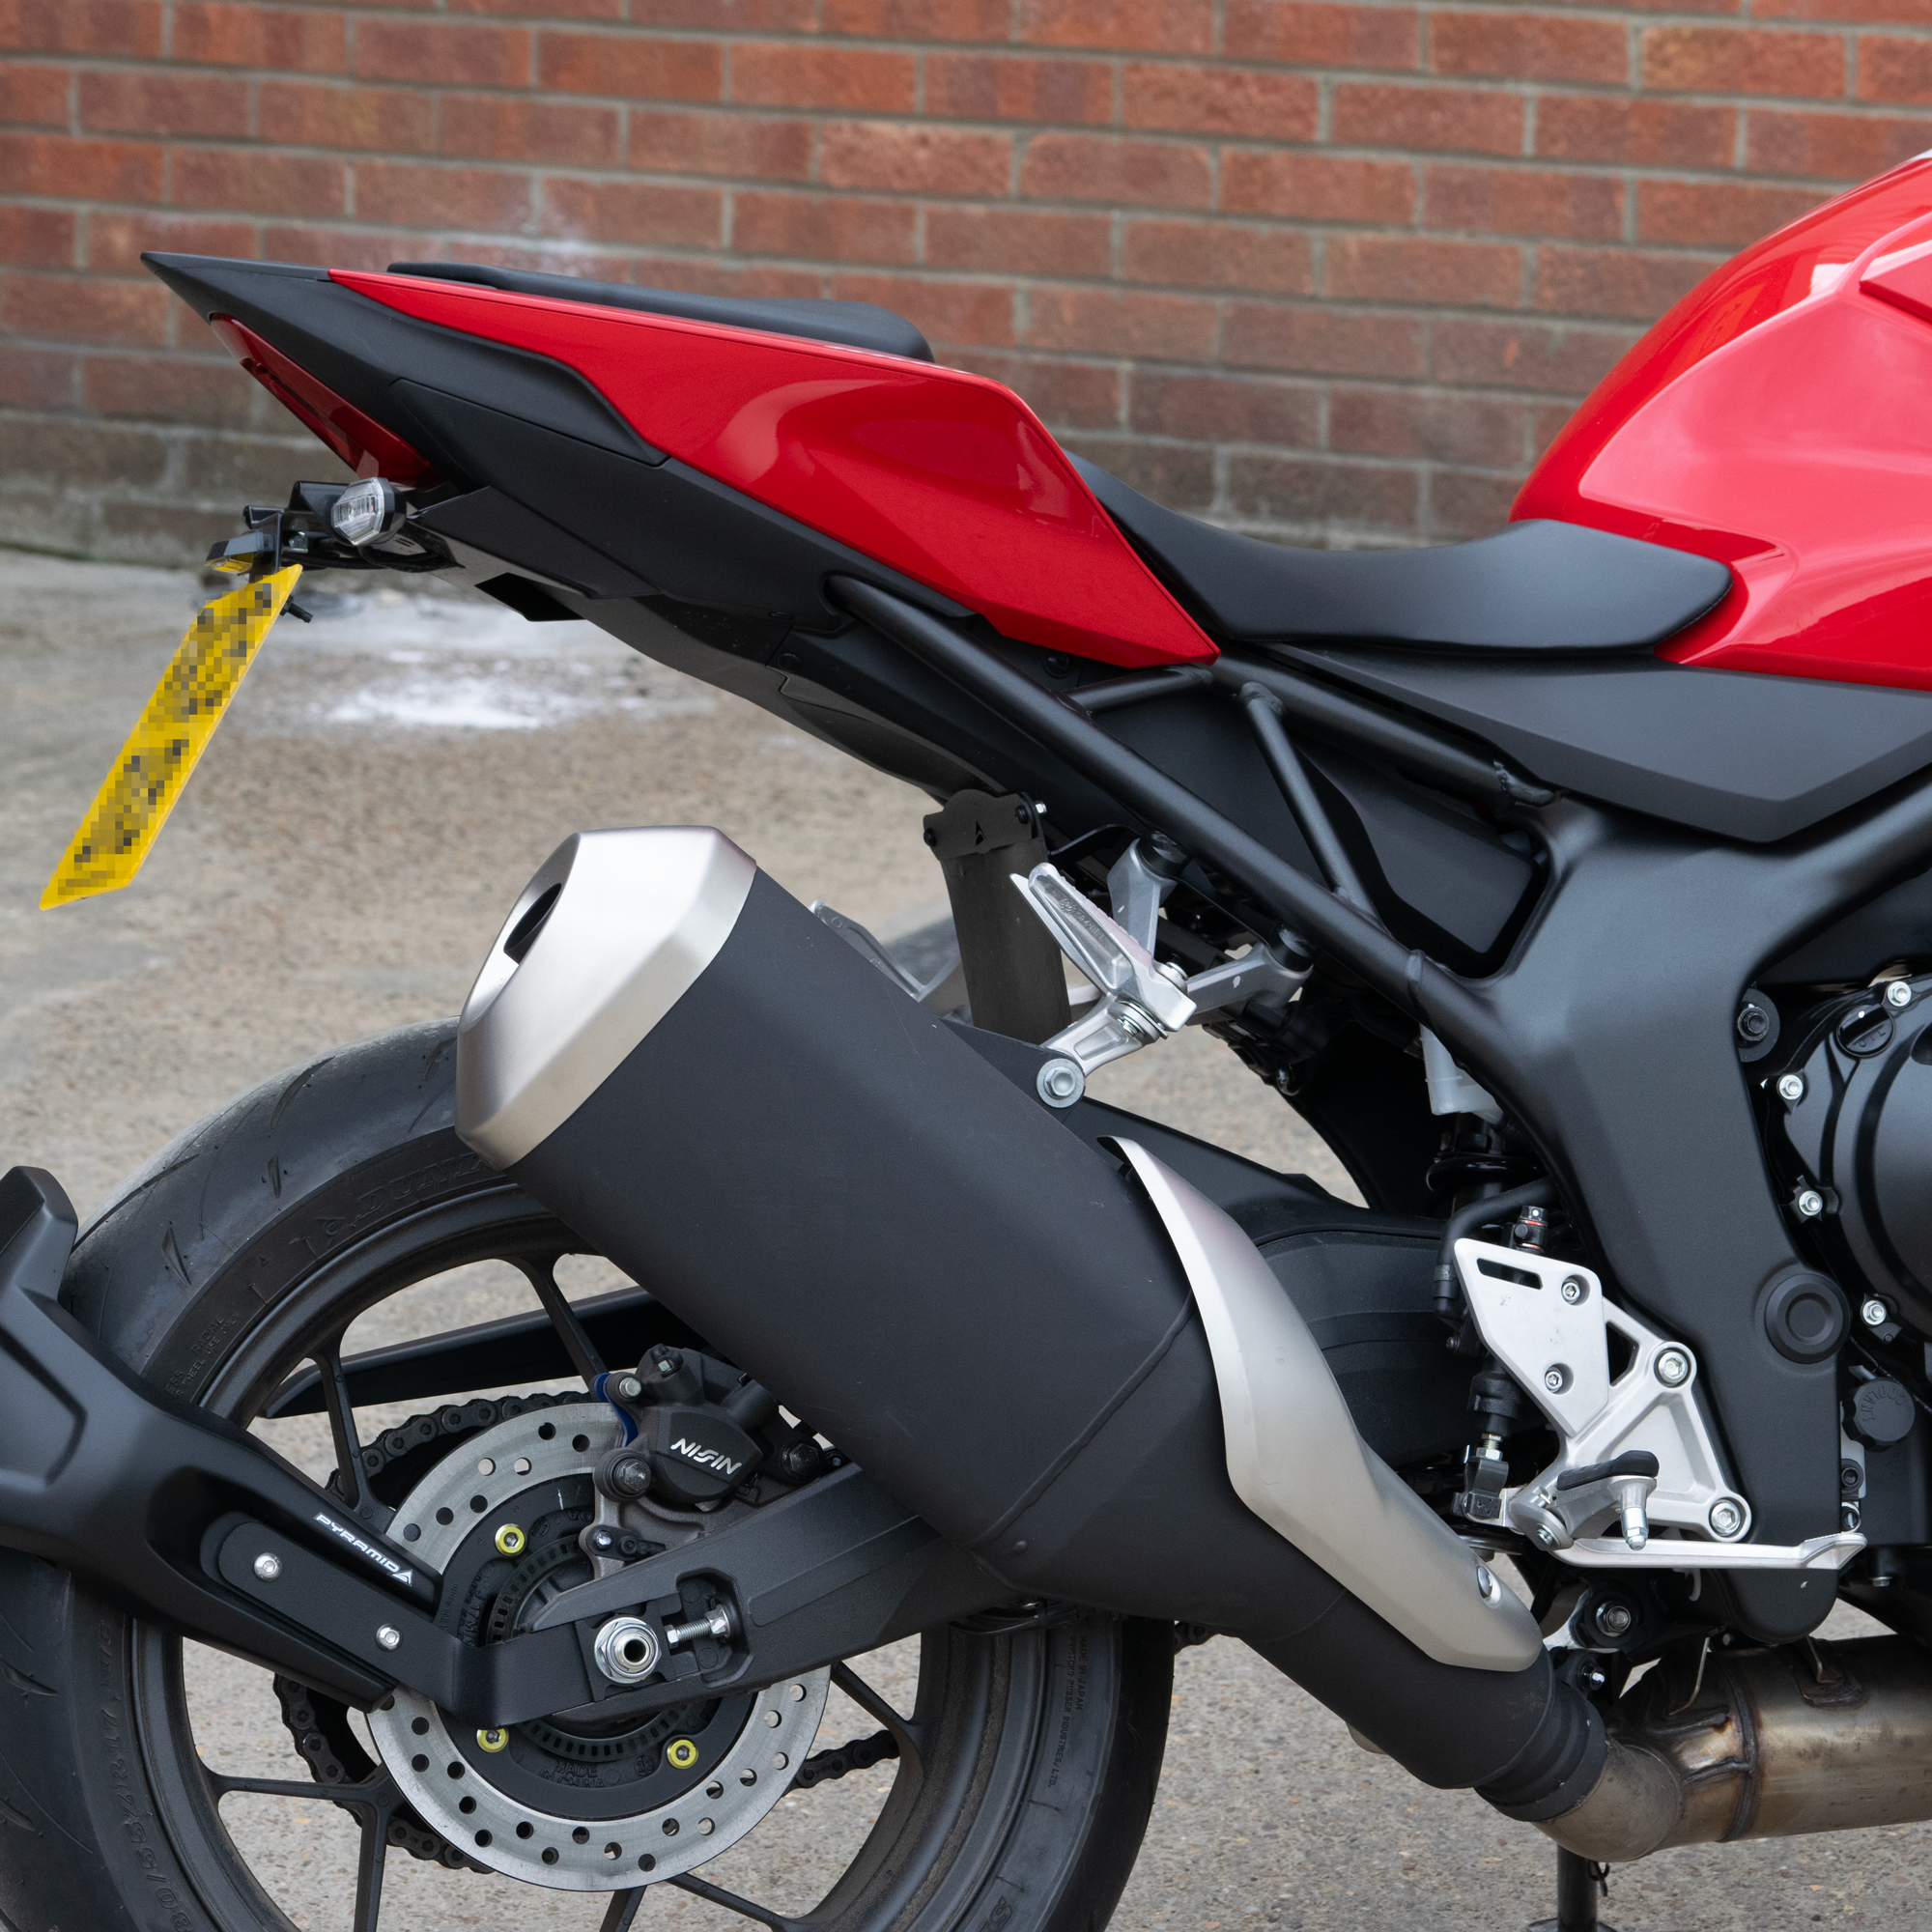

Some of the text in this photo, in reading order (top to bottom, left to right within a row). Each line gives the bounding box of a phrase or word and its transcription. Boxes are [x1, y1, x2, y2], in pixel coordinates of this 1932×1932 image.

[191, 1317, 225, 1356] RADIAL
[182, 1360, 206, 1387] WHEEL
[203, 1336, 220, 1354] USE
[1861, 1385, 1907, 1422] COOLANT
[1078, 1664, 1087, 1675] IN
[1064, 1679, 1075, 1714] RUBBER
[1074, 1677, 1087, 1711] JAPAN
[538, 1768, 607, 1788] IN CHINA
[553, 1760, 598, 1778] MADE
